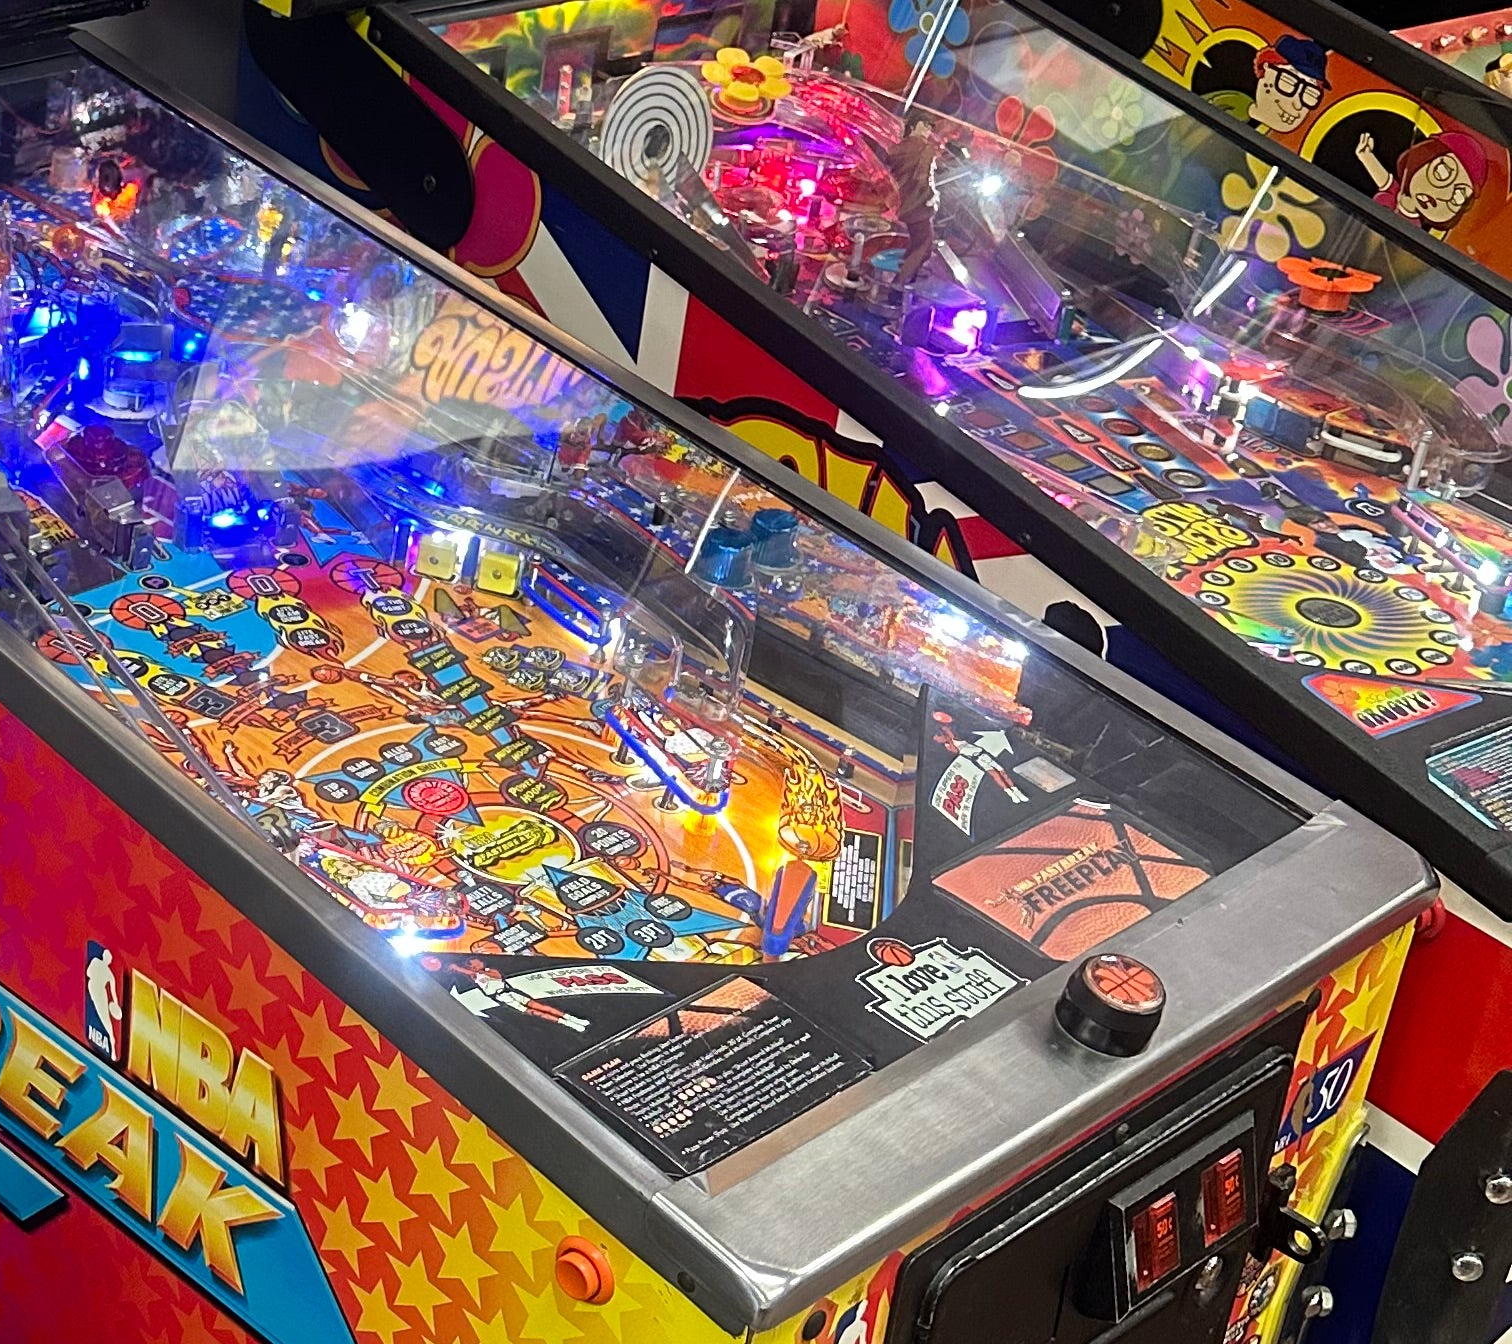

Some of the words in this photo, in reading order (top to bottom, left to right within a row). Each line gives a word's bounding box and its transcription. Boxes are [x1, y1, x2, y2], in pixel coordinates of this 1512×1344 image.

[382, 743, 409, 761] ALLEY
[429, 735, 451, 748] FAST
[346, 760, 370, 774] SLAM
[368, 768, 416, 798] COMBINATION
[417, 760, 452, 774] SHOTS
[520, 782, 546, 805] HOOPS
[943, 774, 970, 820] PASS
[592, 829, 633, 851] POINTS
[559, 875, 592, 895] FIELD
[1022, 838, 1138, 914] FREEPLAY
[566, 881, 603, 901] GOALS
[584, 928, 617, 951] 2PT
[633, 922, 666, 944] 3PT
[552, 972, 629, 988] PASS
[886, 963, 949, 996] love
[944, 968, 1006, 1012] stuff
[895, 996, 956, 1029] this
[88, 1024, 110, 1054] NBA
[128, 967, 286, 1187] NBA
[1307, 1057, 1354, 1124] 50
